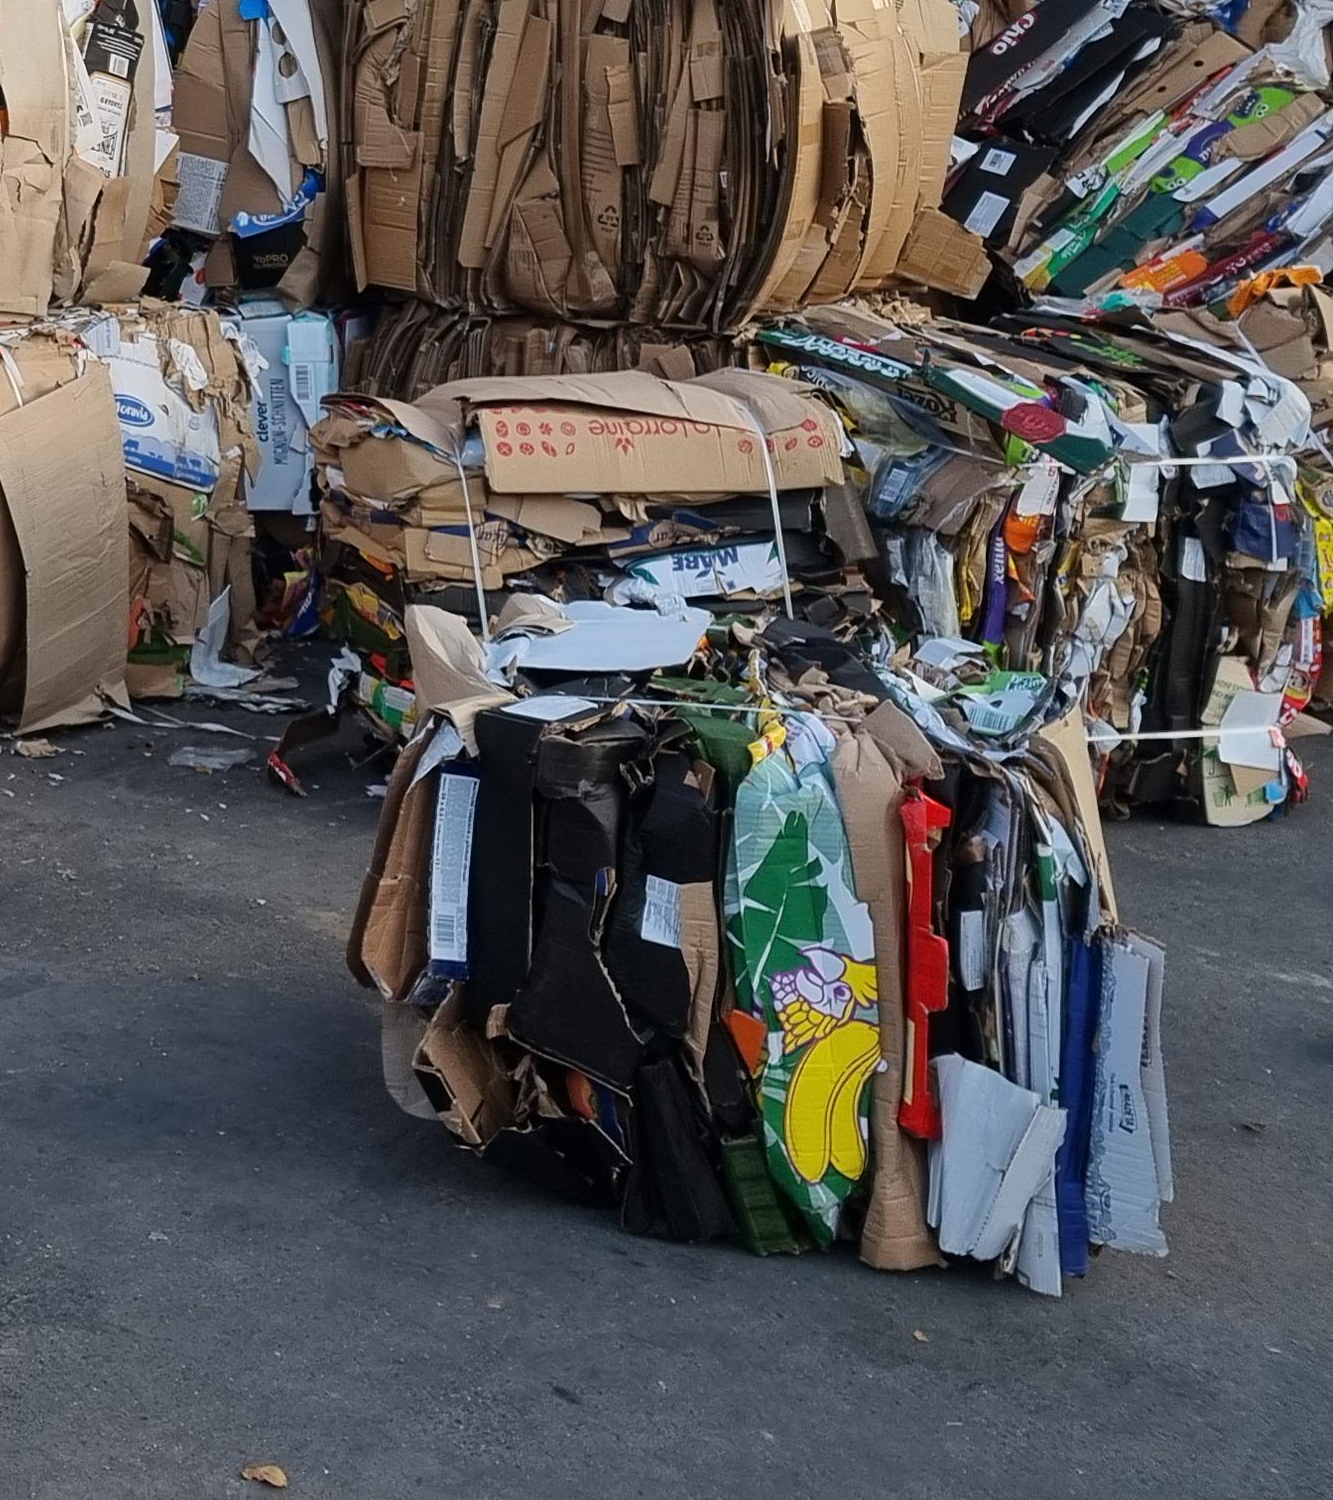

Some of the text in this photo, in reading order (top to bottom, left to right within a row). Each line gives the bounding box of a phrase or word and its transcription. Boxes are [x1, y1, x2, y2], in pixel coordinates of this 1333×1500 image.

[992, 12, 1037, 57] Chio
[257, 399, 269, 444] clever
[273, 377, 285, 466] MIGNON-SCHNITTEN
[589, 418, 688, 437] Lorraine
